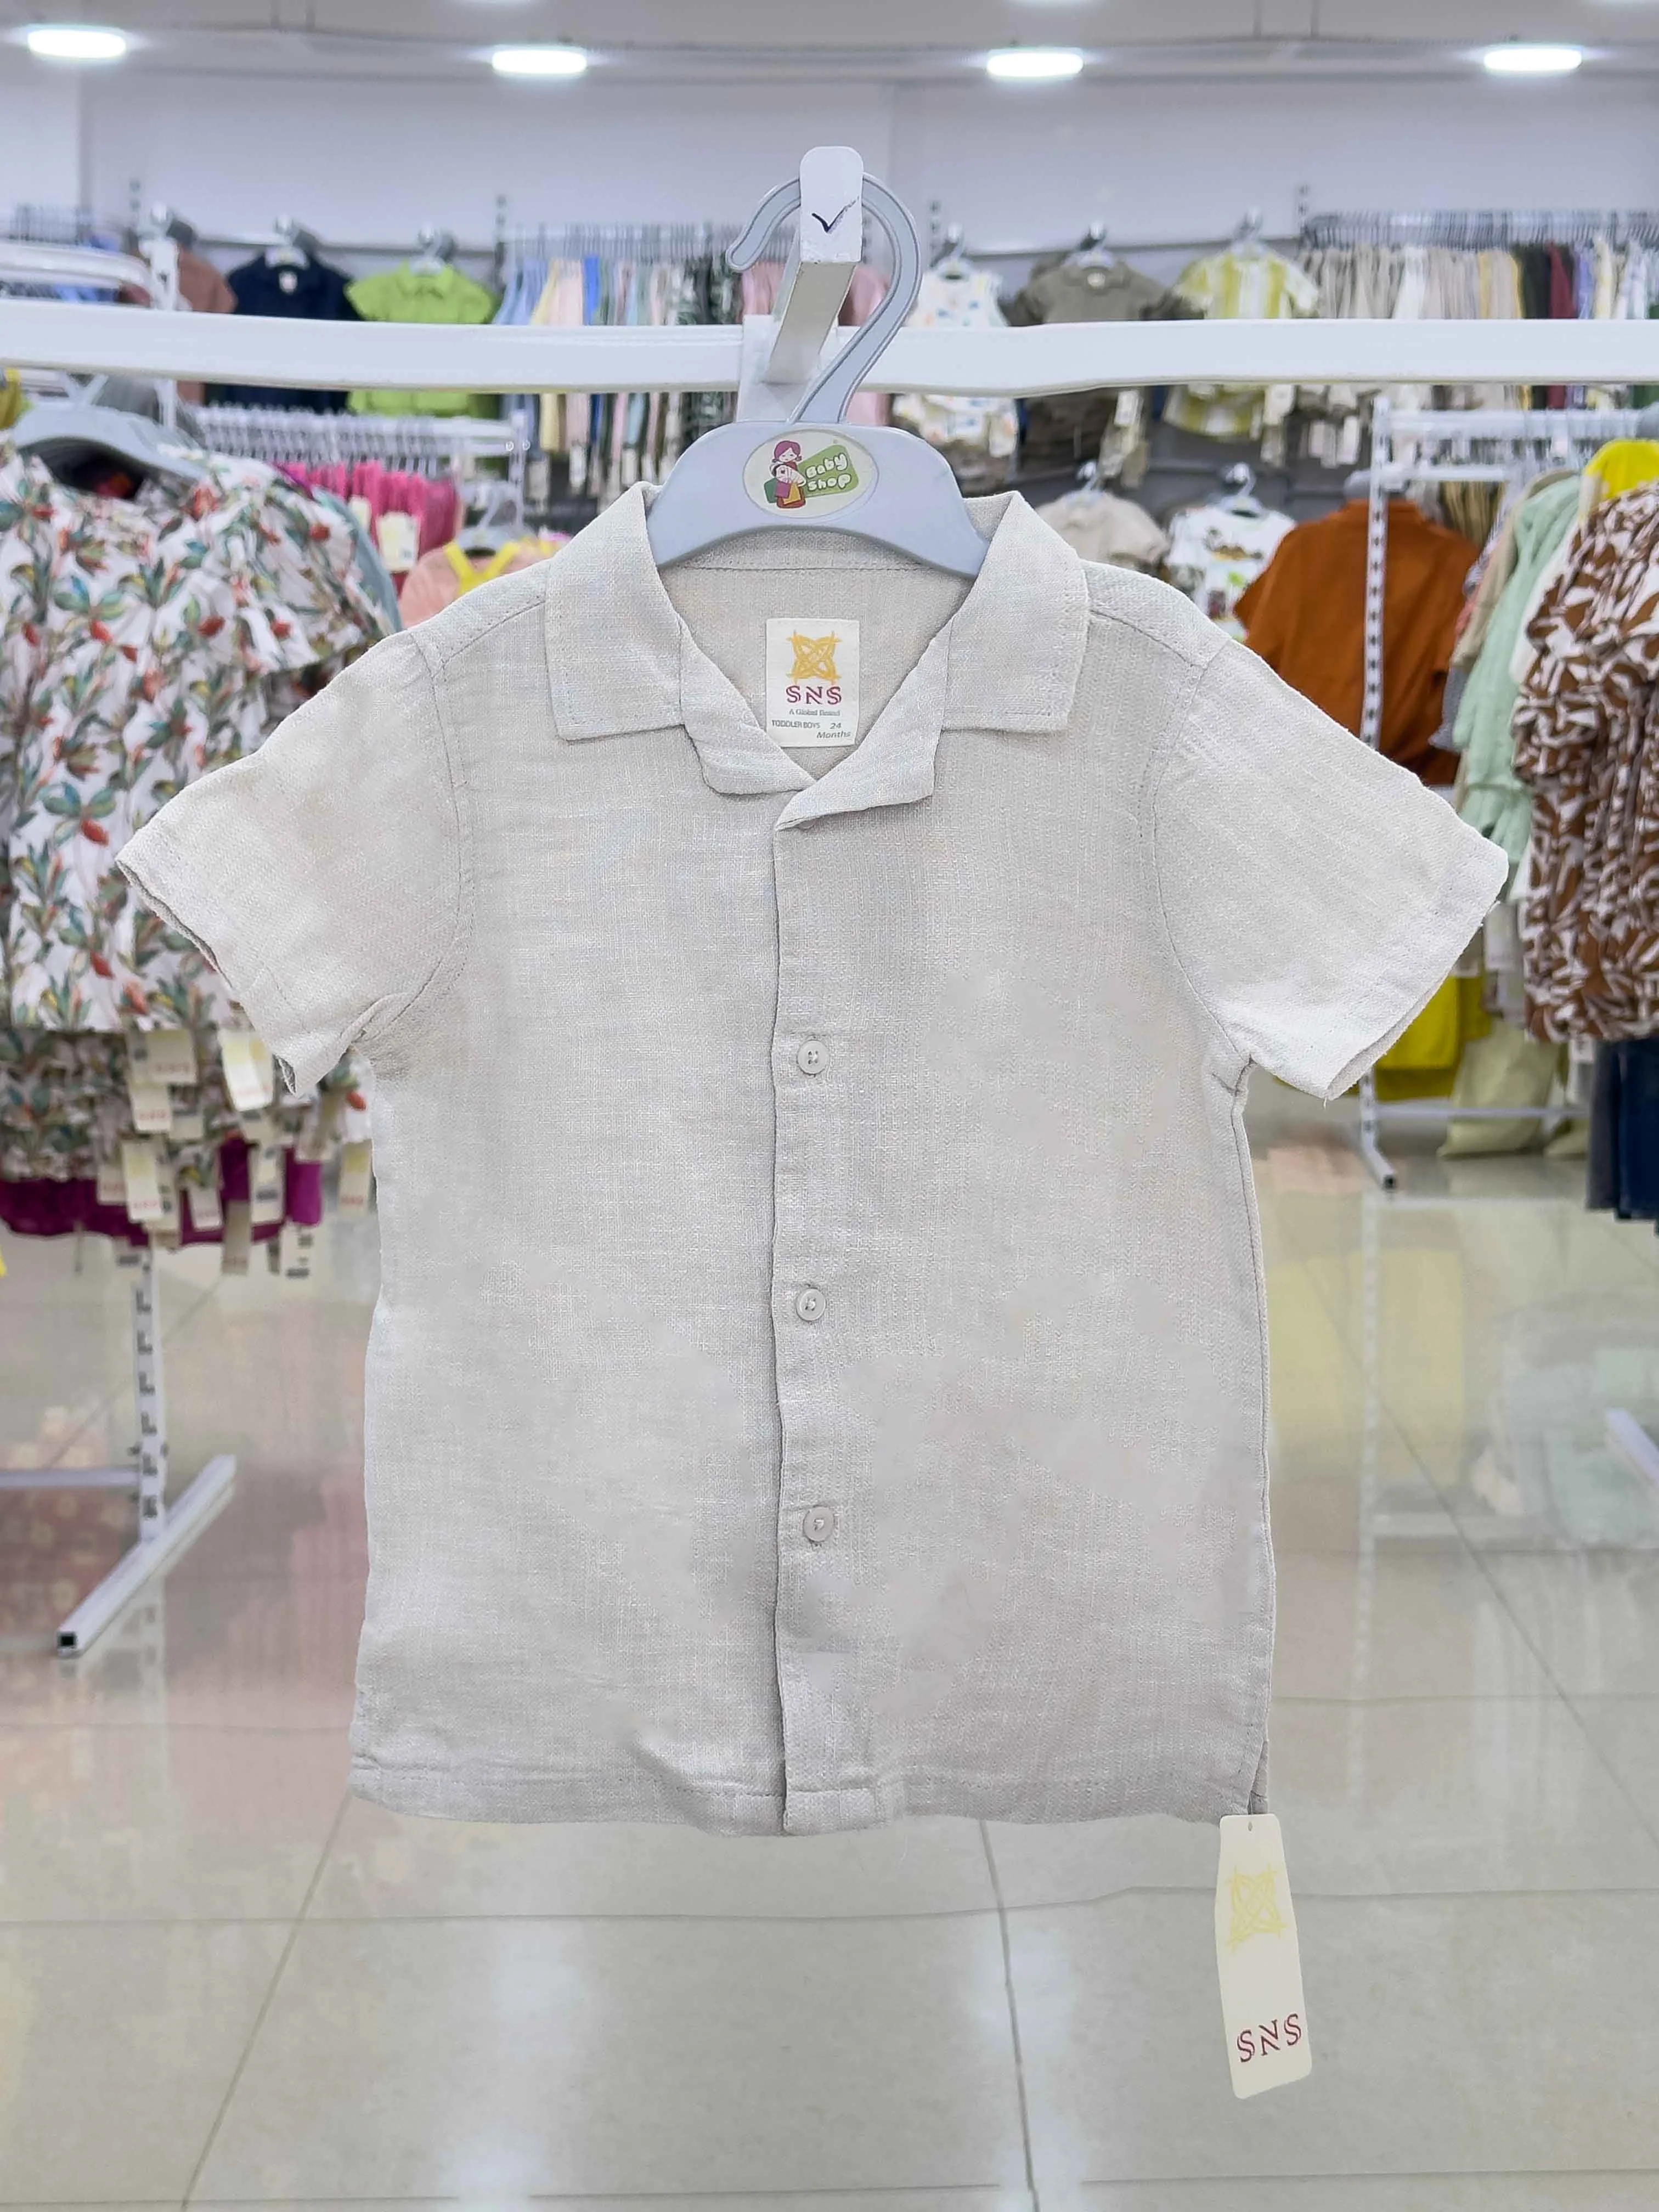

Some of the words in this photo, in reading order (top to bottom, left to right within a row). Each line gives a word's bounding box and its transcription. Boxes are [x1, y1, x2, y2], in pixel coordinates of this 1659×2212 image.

[806, 453, 848, 478] Baby
[786, 686, 842, 705] SNS
[772, 719, 802, 727] TODDLER
[1237, 2013, 1302, 2063] SNS
